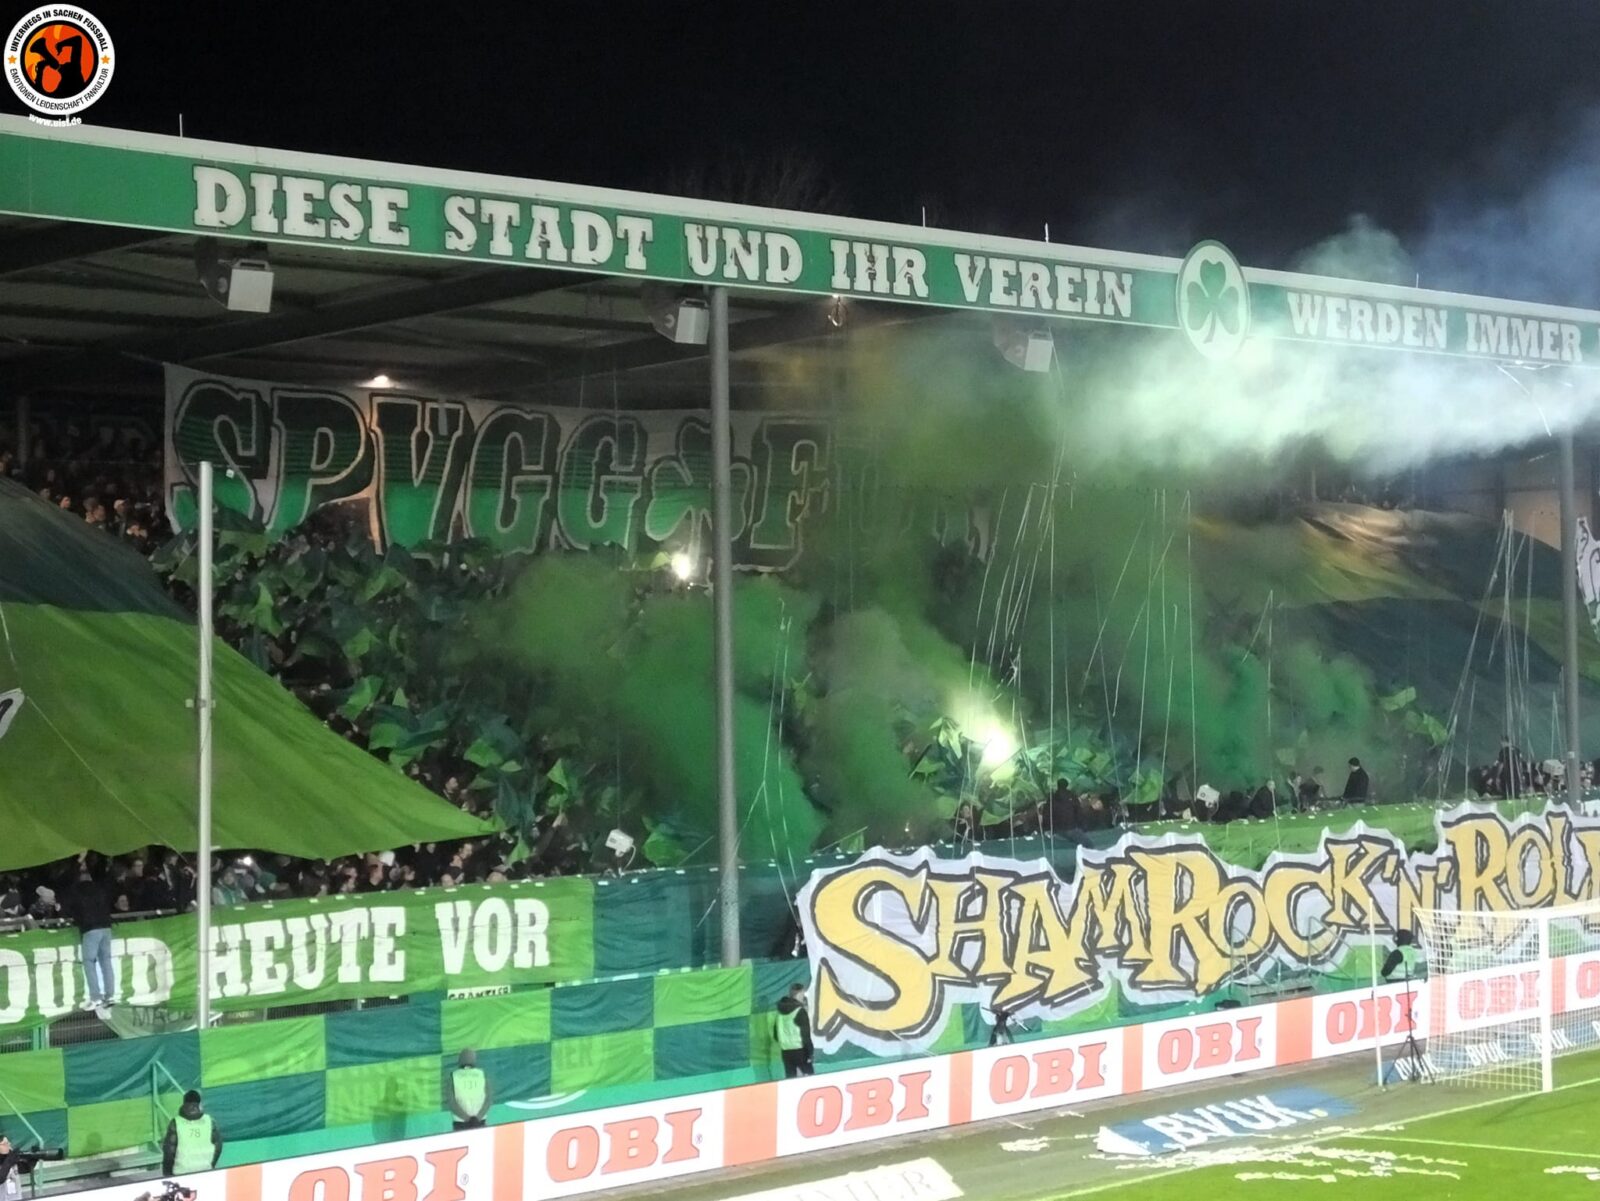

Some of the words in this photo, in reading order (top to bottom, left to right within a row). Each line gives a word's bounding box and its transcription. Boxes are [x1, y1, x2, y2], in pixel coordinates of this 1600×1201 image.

[193, 165, 410, 247] DIESE
[444, 195, 653, 271] STADT
[684, 223, 803, 284] UND
[830, 238, 929, 297] IHR
[954, 253, 1133, 318] VEREIN
[1287, 291, 1448, 349] WERDEN
[1465, 312, 1583, 362] IMMER
[209, 906, 406, 999] HEUTE
[435, 897, 550, 974] VOR
[1326, 991, 1418, 1045] OBI
[1458, 970, 1540, 1020] OBI
[989, 1043, 1108, 1105] OBI
[1157, 1016, 1263, 1074] OBI
[797, 1070, 931, 1139] OBI
[288, 1146, 469, 1201] OBI
[546, 1108, 702, 1183] OBI
